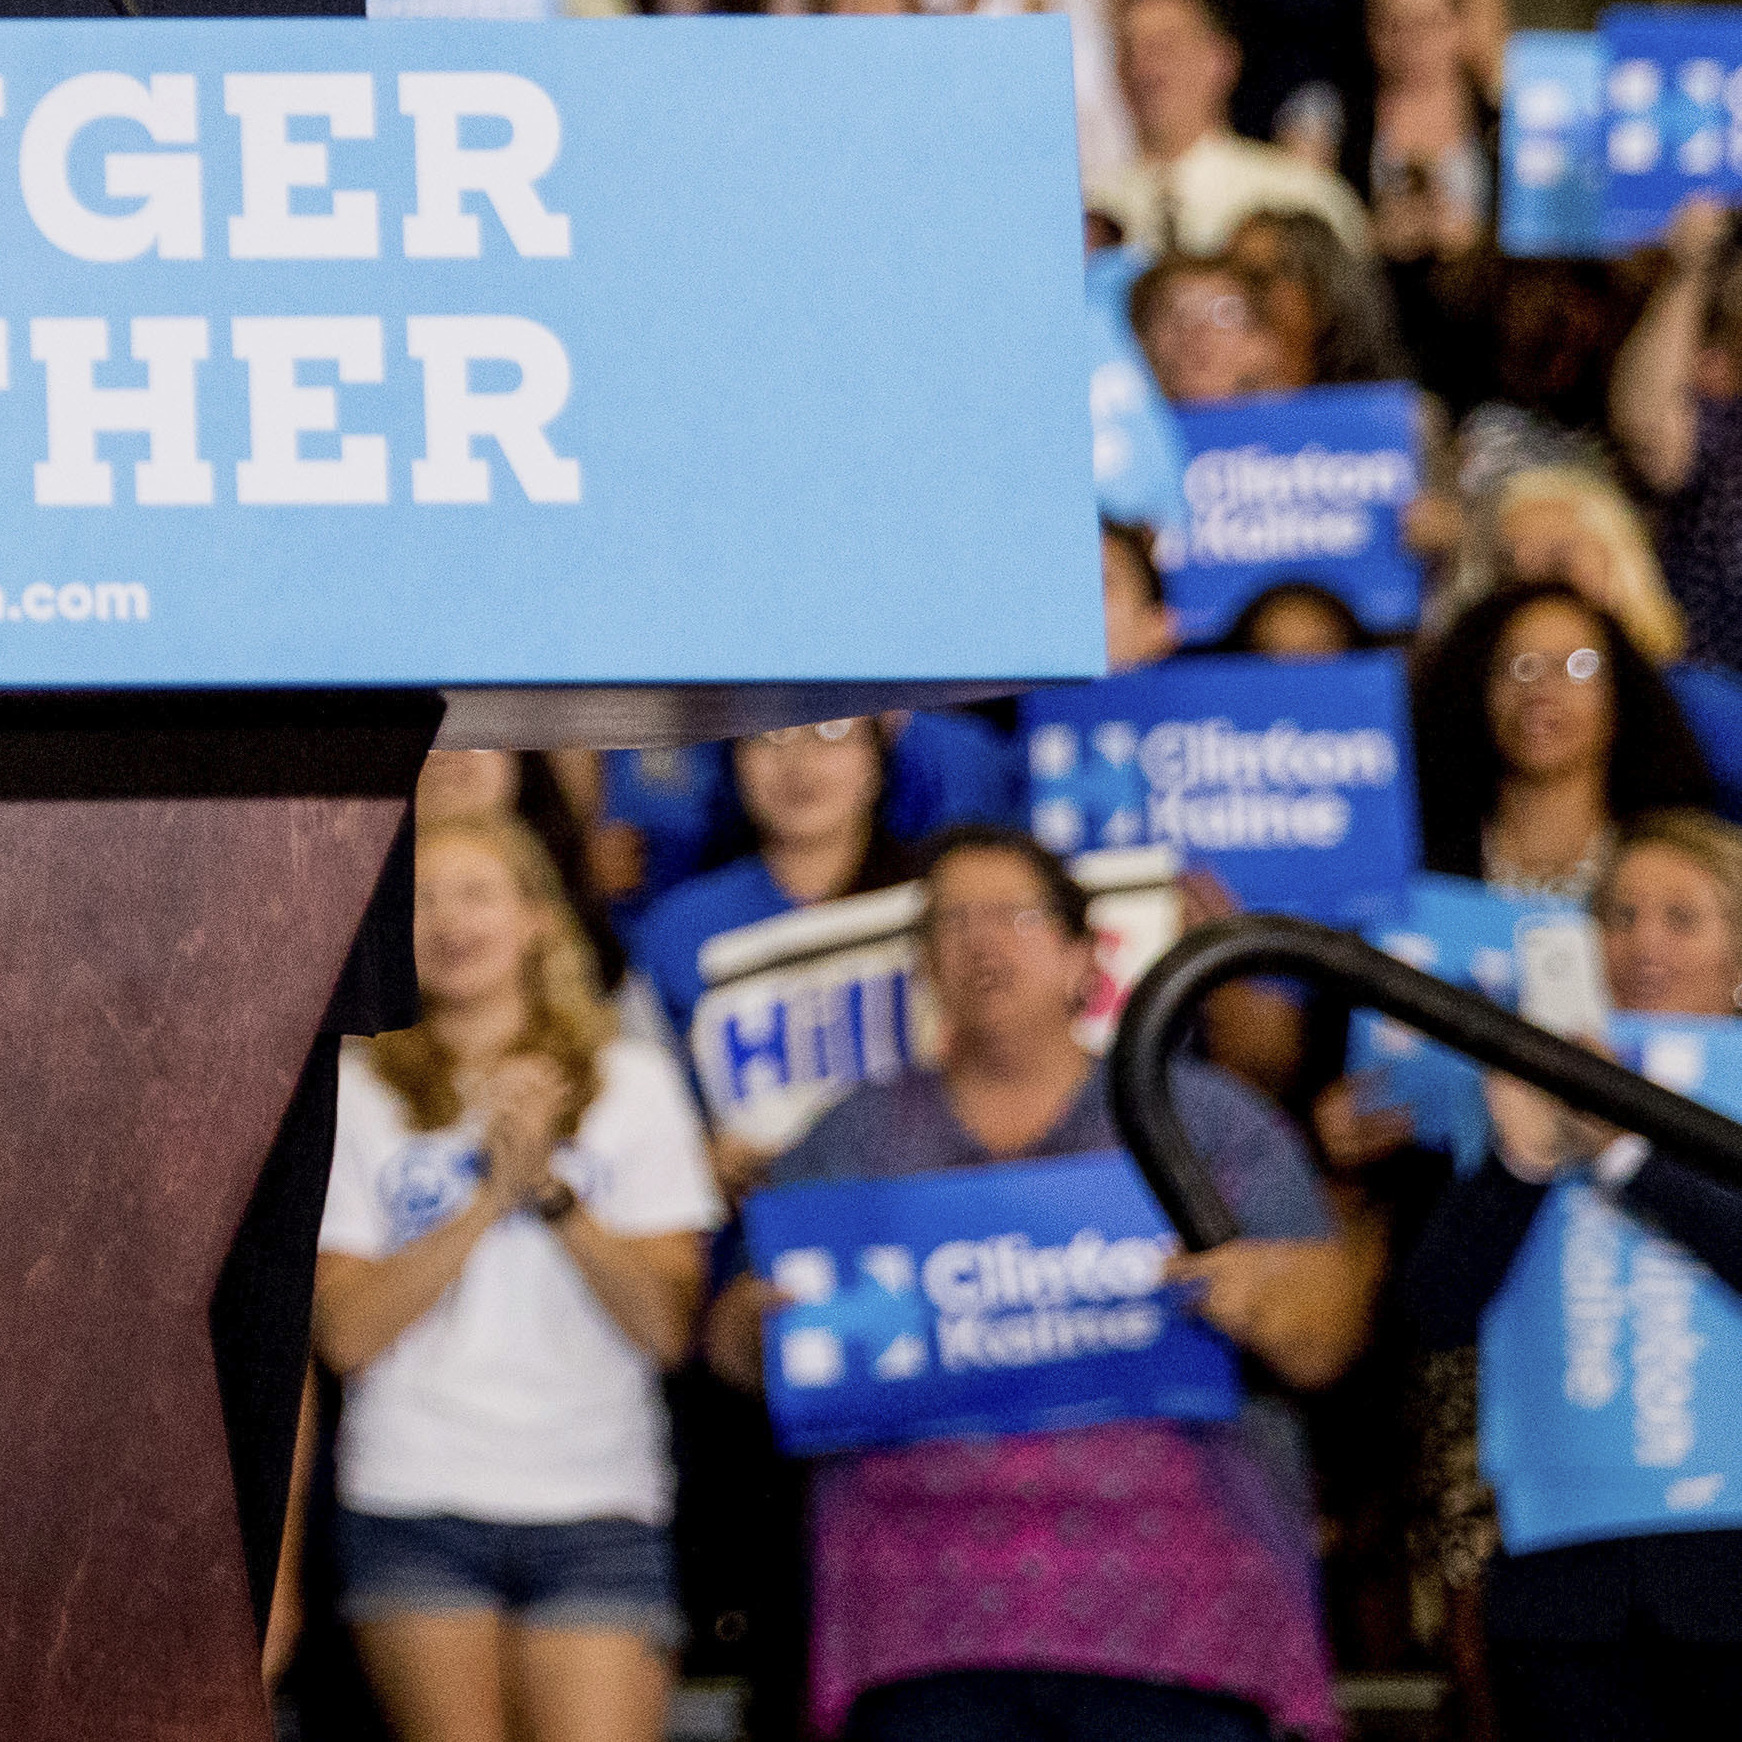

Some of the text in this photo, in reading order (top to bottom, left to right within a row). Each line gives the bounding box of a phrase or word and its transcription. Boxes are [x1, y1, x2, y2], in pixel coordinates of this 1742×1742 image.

[1138, 718, 1398, 791] Clinton
[1147, 788, 1354, 852] Kaine
[922, 1227, 1180, 1316] Clinto
[937, 1303, 1166, 1375] Kaine
[1630, 1240, 1710, 1468] linton
